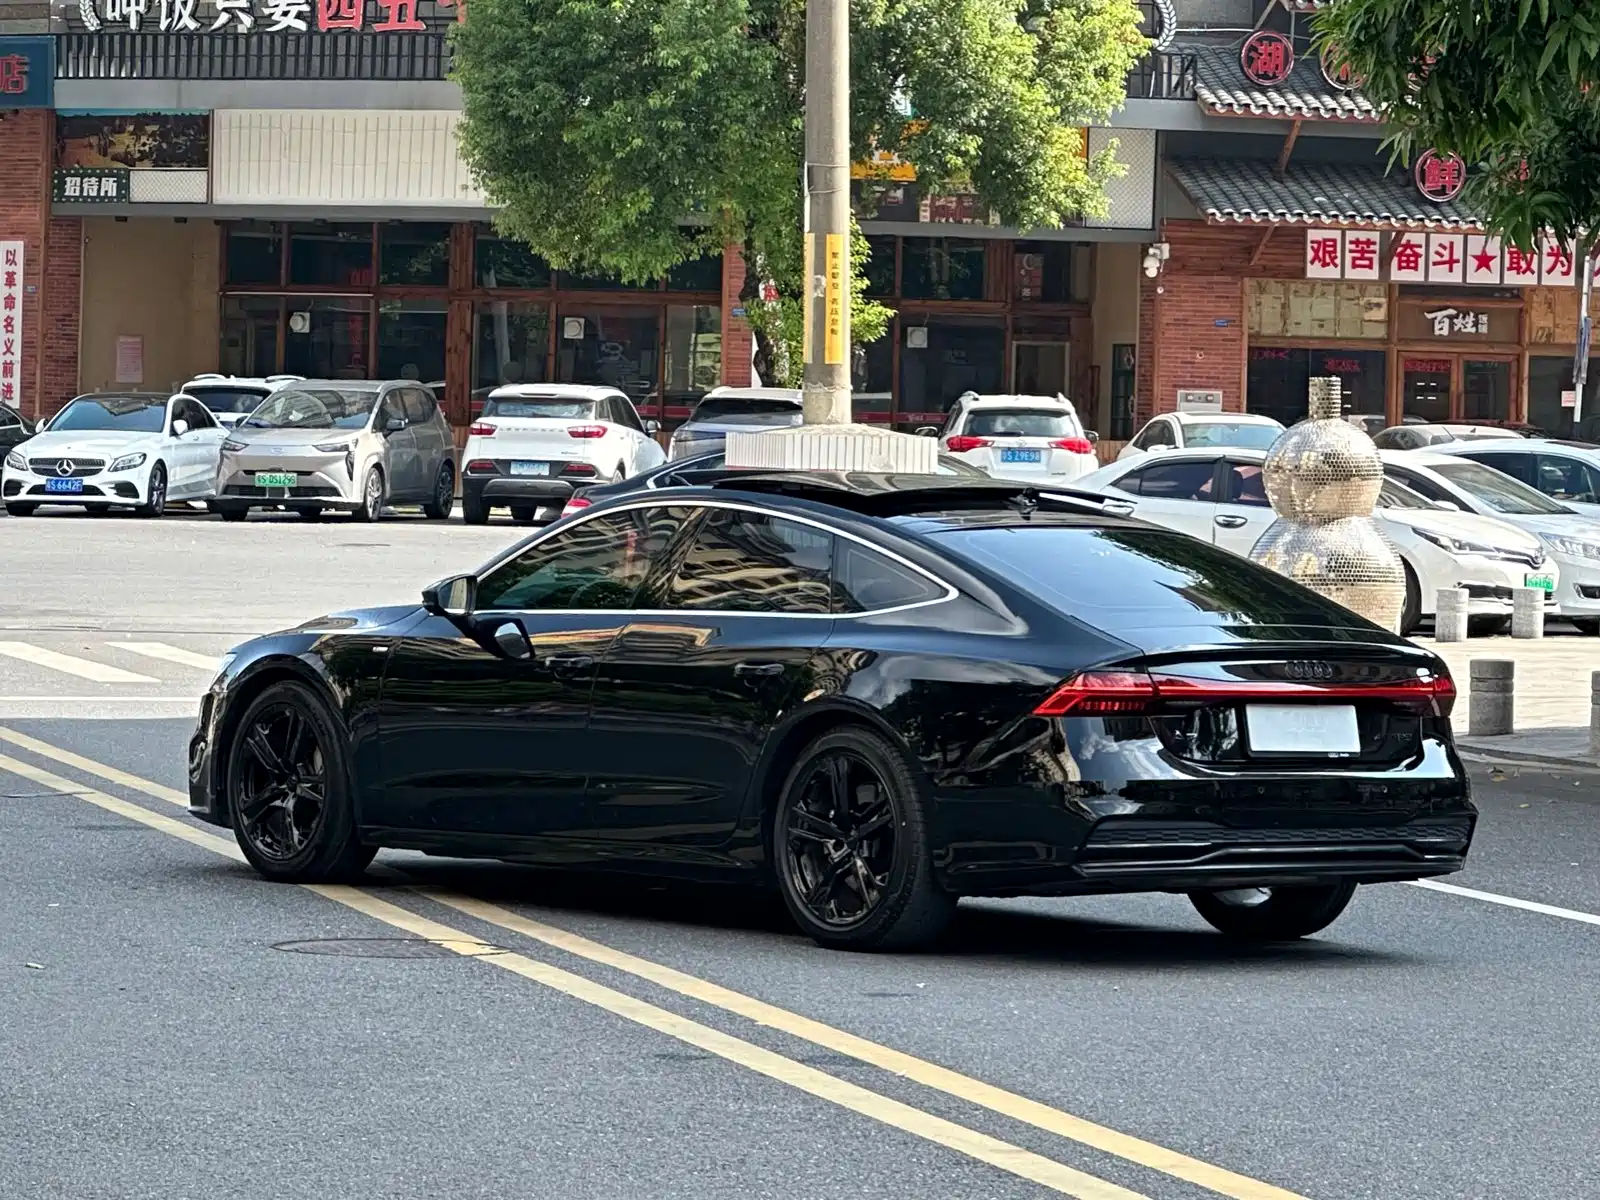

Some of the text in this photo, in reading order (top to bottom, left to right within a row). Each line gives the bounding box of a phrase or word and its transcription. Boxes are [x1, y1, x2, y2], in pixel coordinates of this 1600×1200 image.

[1251, 41, 1285, 77] 湖
[64, 177, 117, 197] 招待所
[1424, 157, 1460, 194] 鲜
[1, 249, 17, 400] 以革命名义前进
